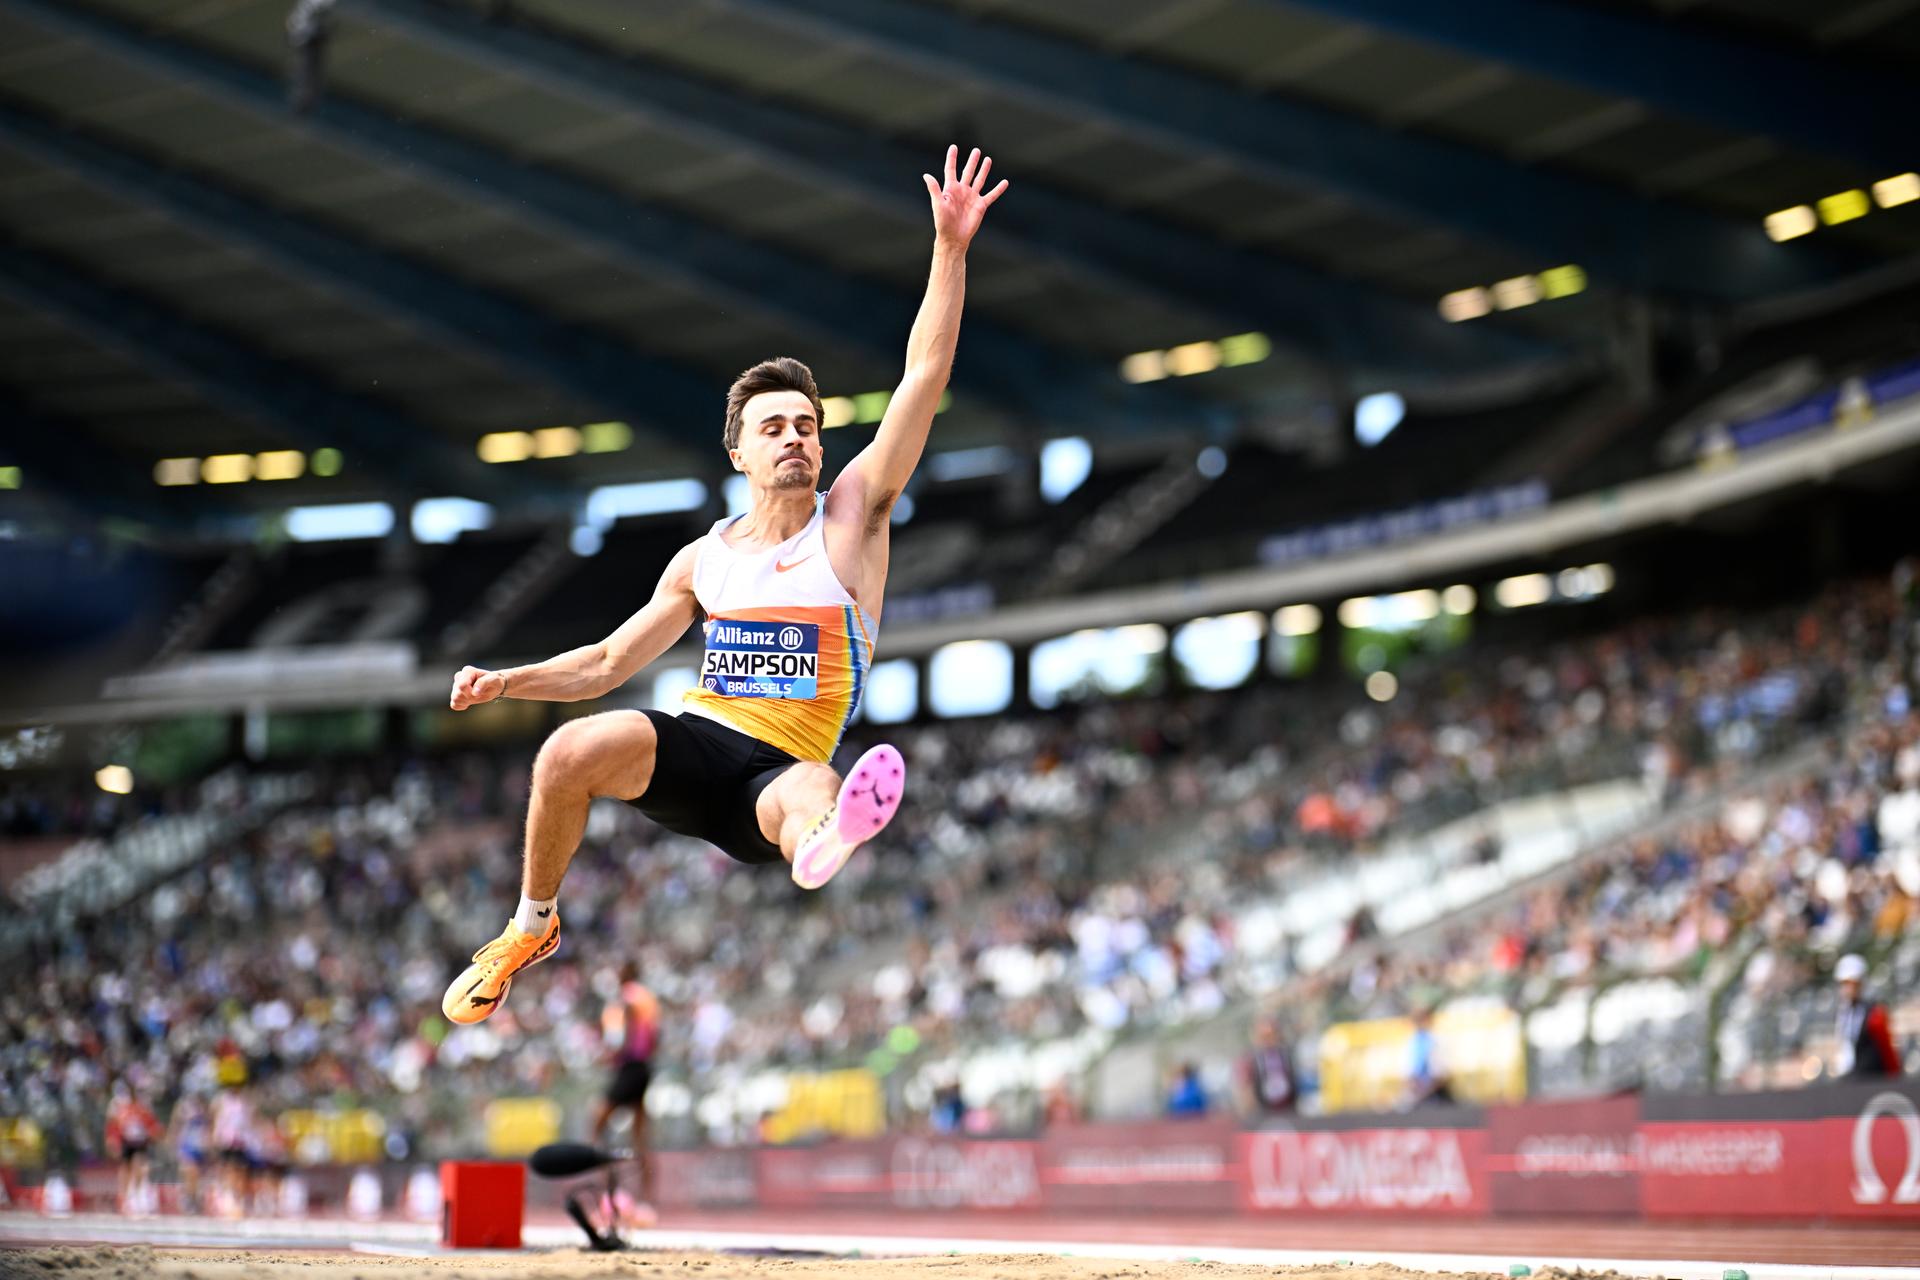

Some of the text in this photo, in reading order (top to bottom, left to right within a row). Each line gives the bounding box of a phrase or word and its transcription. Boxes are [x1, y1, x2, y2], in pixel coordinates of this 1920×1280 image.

[715, 626, 775, 645] Allianz
[706, 652, 816, 677] SAMPSON
[727, 681, 792, 695] BRUSSELS
